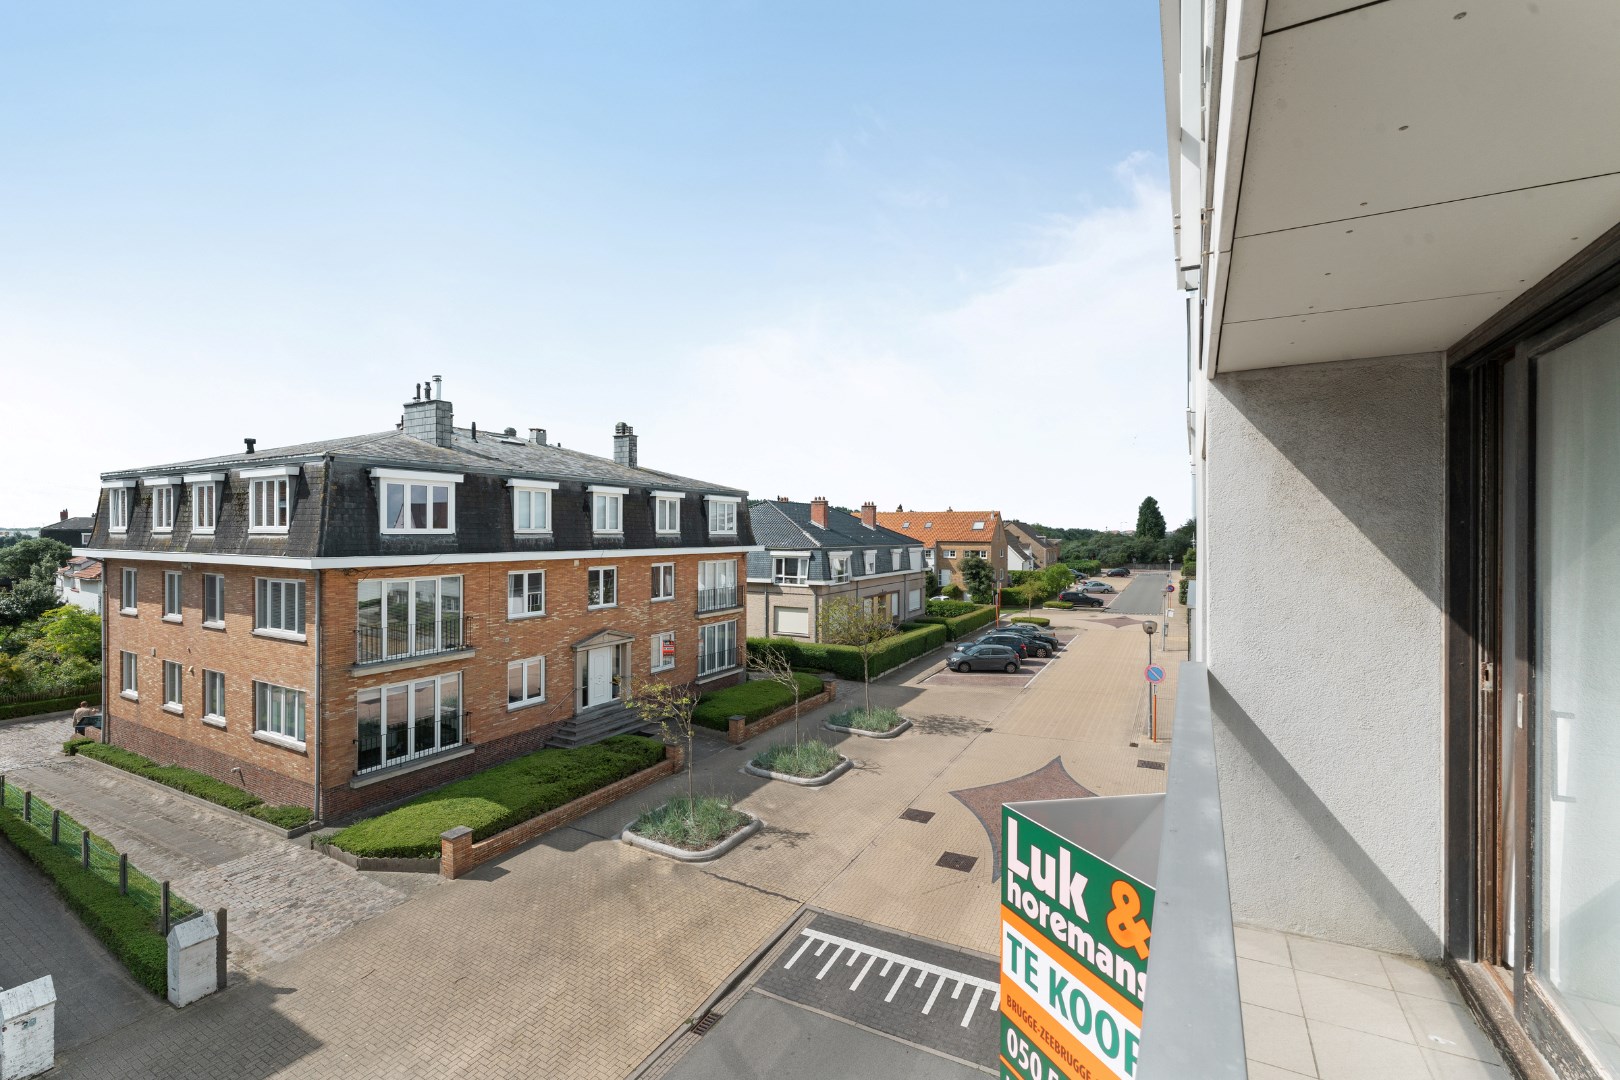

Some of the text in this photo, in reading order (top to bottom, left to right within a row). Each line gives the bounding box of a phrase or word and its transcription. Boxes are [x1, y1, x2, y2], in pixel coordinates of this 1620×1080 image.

[1007, 816, 1089, 923] Luk
[1106, 880, 1151, 960] &
[1006, 931, 1038, 993] TE
[1006, 1028, 1042, 1080] 050
